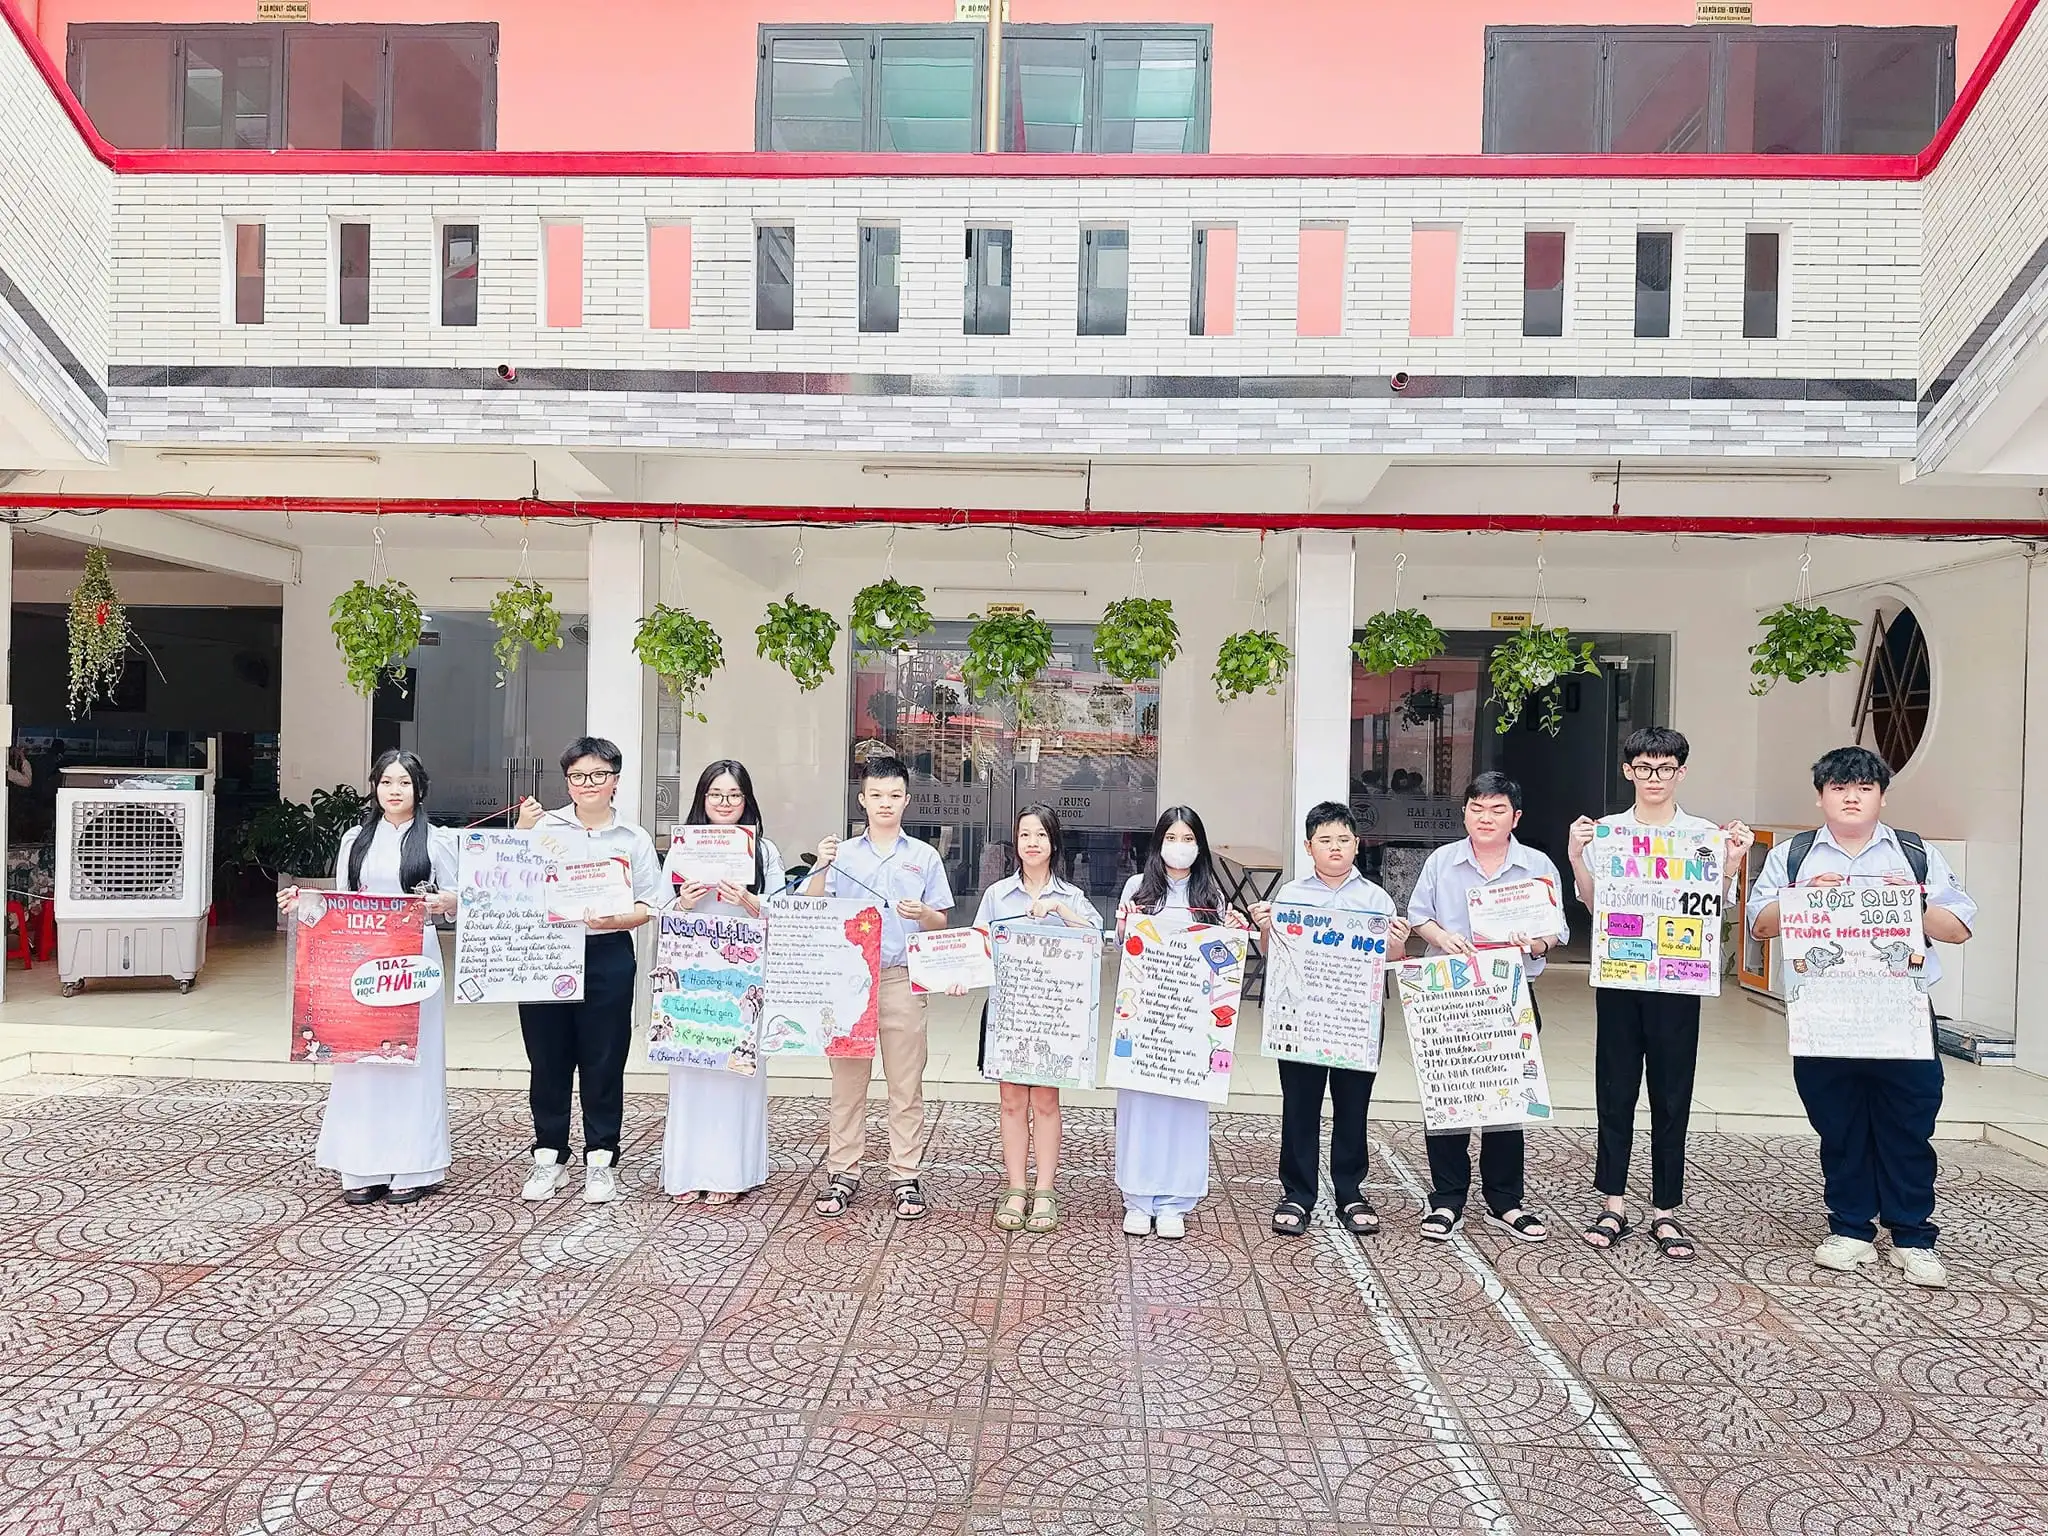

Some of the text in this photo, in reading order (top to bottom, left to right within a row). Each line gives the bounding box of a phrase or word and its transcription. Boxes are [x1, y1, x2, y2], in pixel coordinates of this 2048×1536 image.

[1632, 835, 1676, 856] HAI
[793, 899, 811, 912] QUY
[1678, 891, 1722, 917] 12C1
[1861, 888, 1915, 907] QUY
[346, 912, 387, 930] 10A2
[1303, 913, 1332, 928] QUY
[1312, 927, 1386, 956] LỚP HỌC
[375, 958, 410, 971] 10A2
[1423, 955, 1487, 992] 11B1
